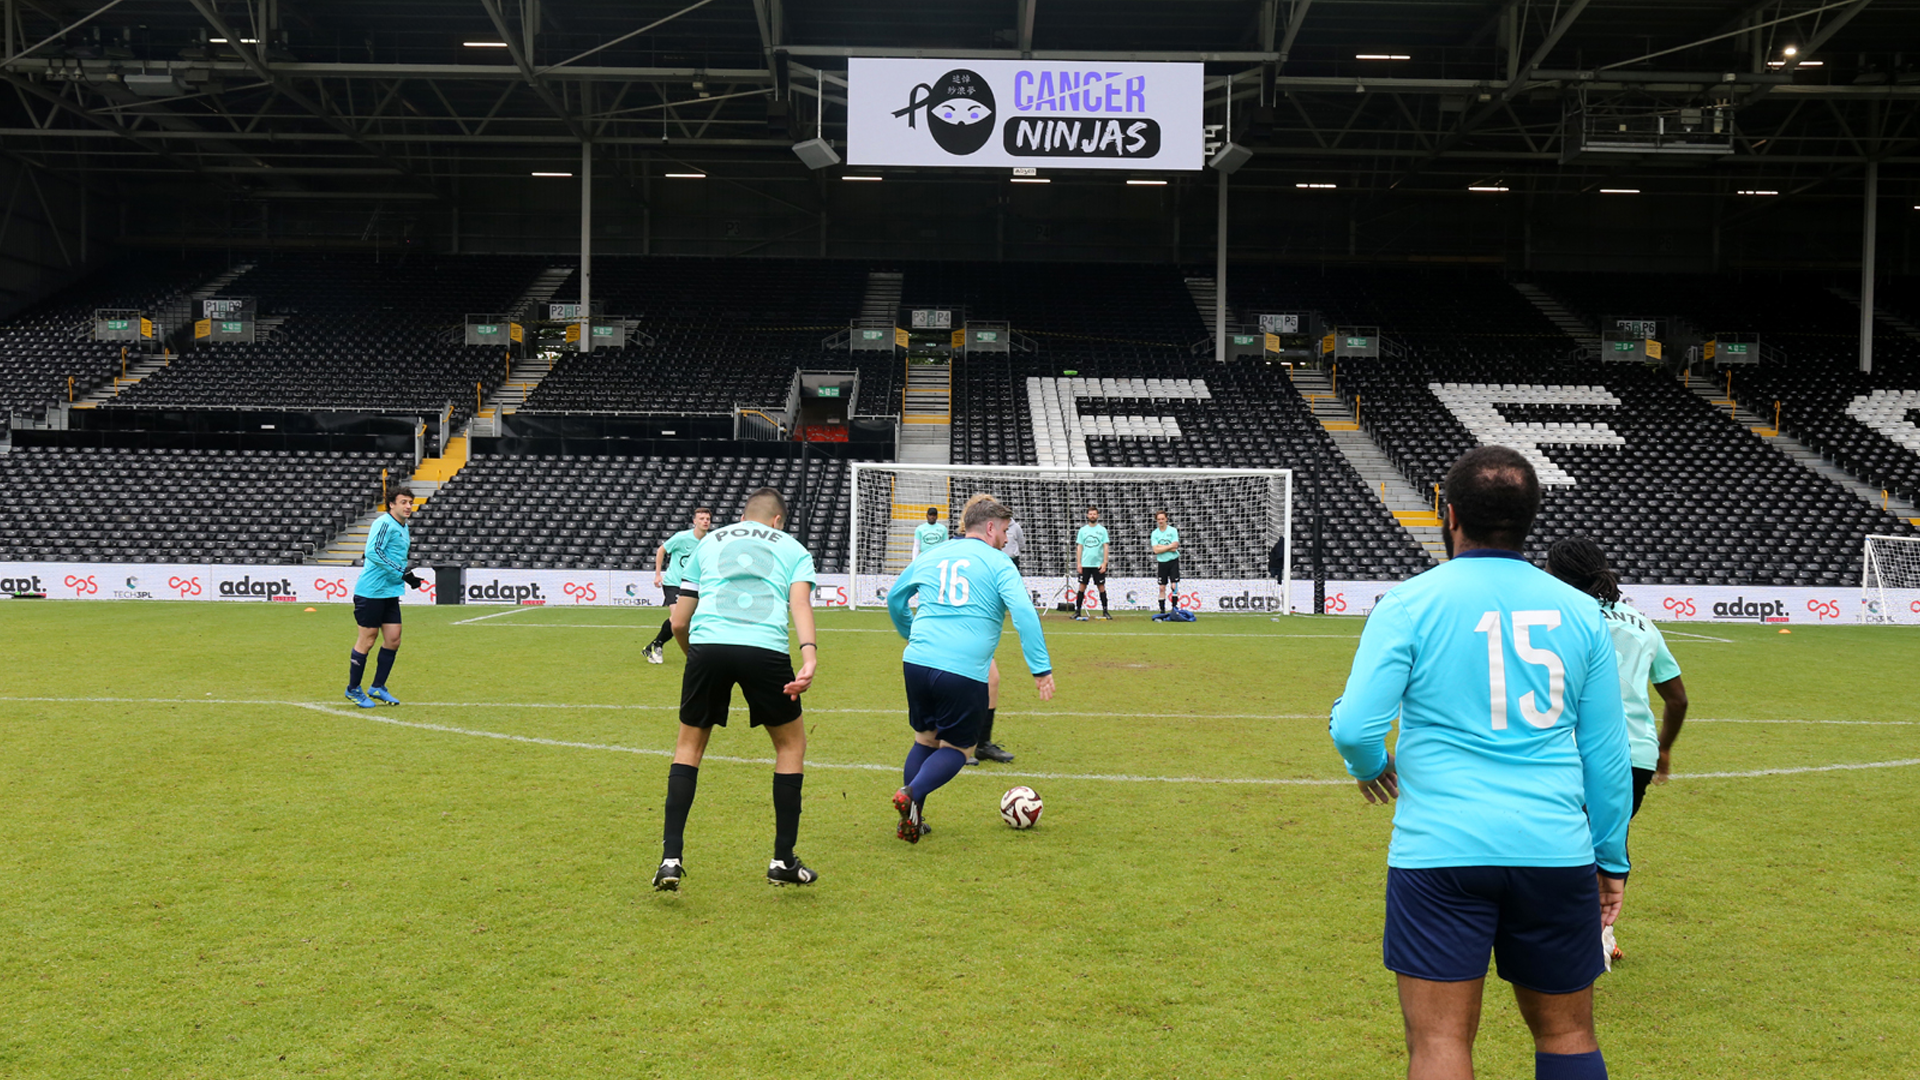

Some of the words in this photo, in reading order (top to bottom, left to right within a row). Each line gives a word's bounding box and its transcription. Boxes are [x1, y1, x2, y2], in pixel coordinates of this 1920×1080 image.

[1014, 70, 1146, 113] CANCER
[1015, 119, 1148, 156] NINJAS
[206, 301, 217, 311] P1
[551, 305, 564, 316] P2
[913, 312, 926, 323] P3
[937, 312, 950, 323] P4
[1261, 316, 1273, 326] P4
[1284, 316, 1297, 327] P5
[1642, 322, 1655, 333] P6
[714, 528, 783, 543] PONE
[0, 575, 47, 598] apt.
[219, 575, 297, 602] adapt.
[468, 579, 546, 605] adapt.
[715, 538, 775, 624] 8
[936, 559, 971, 606] 16
[1218, 590, 1296, 612] adap.
[1713, 596, 1790, 623] adapt.
[1600, 609, 1647, 632] ANTE
[1473, 609, 1565, 730] 15
